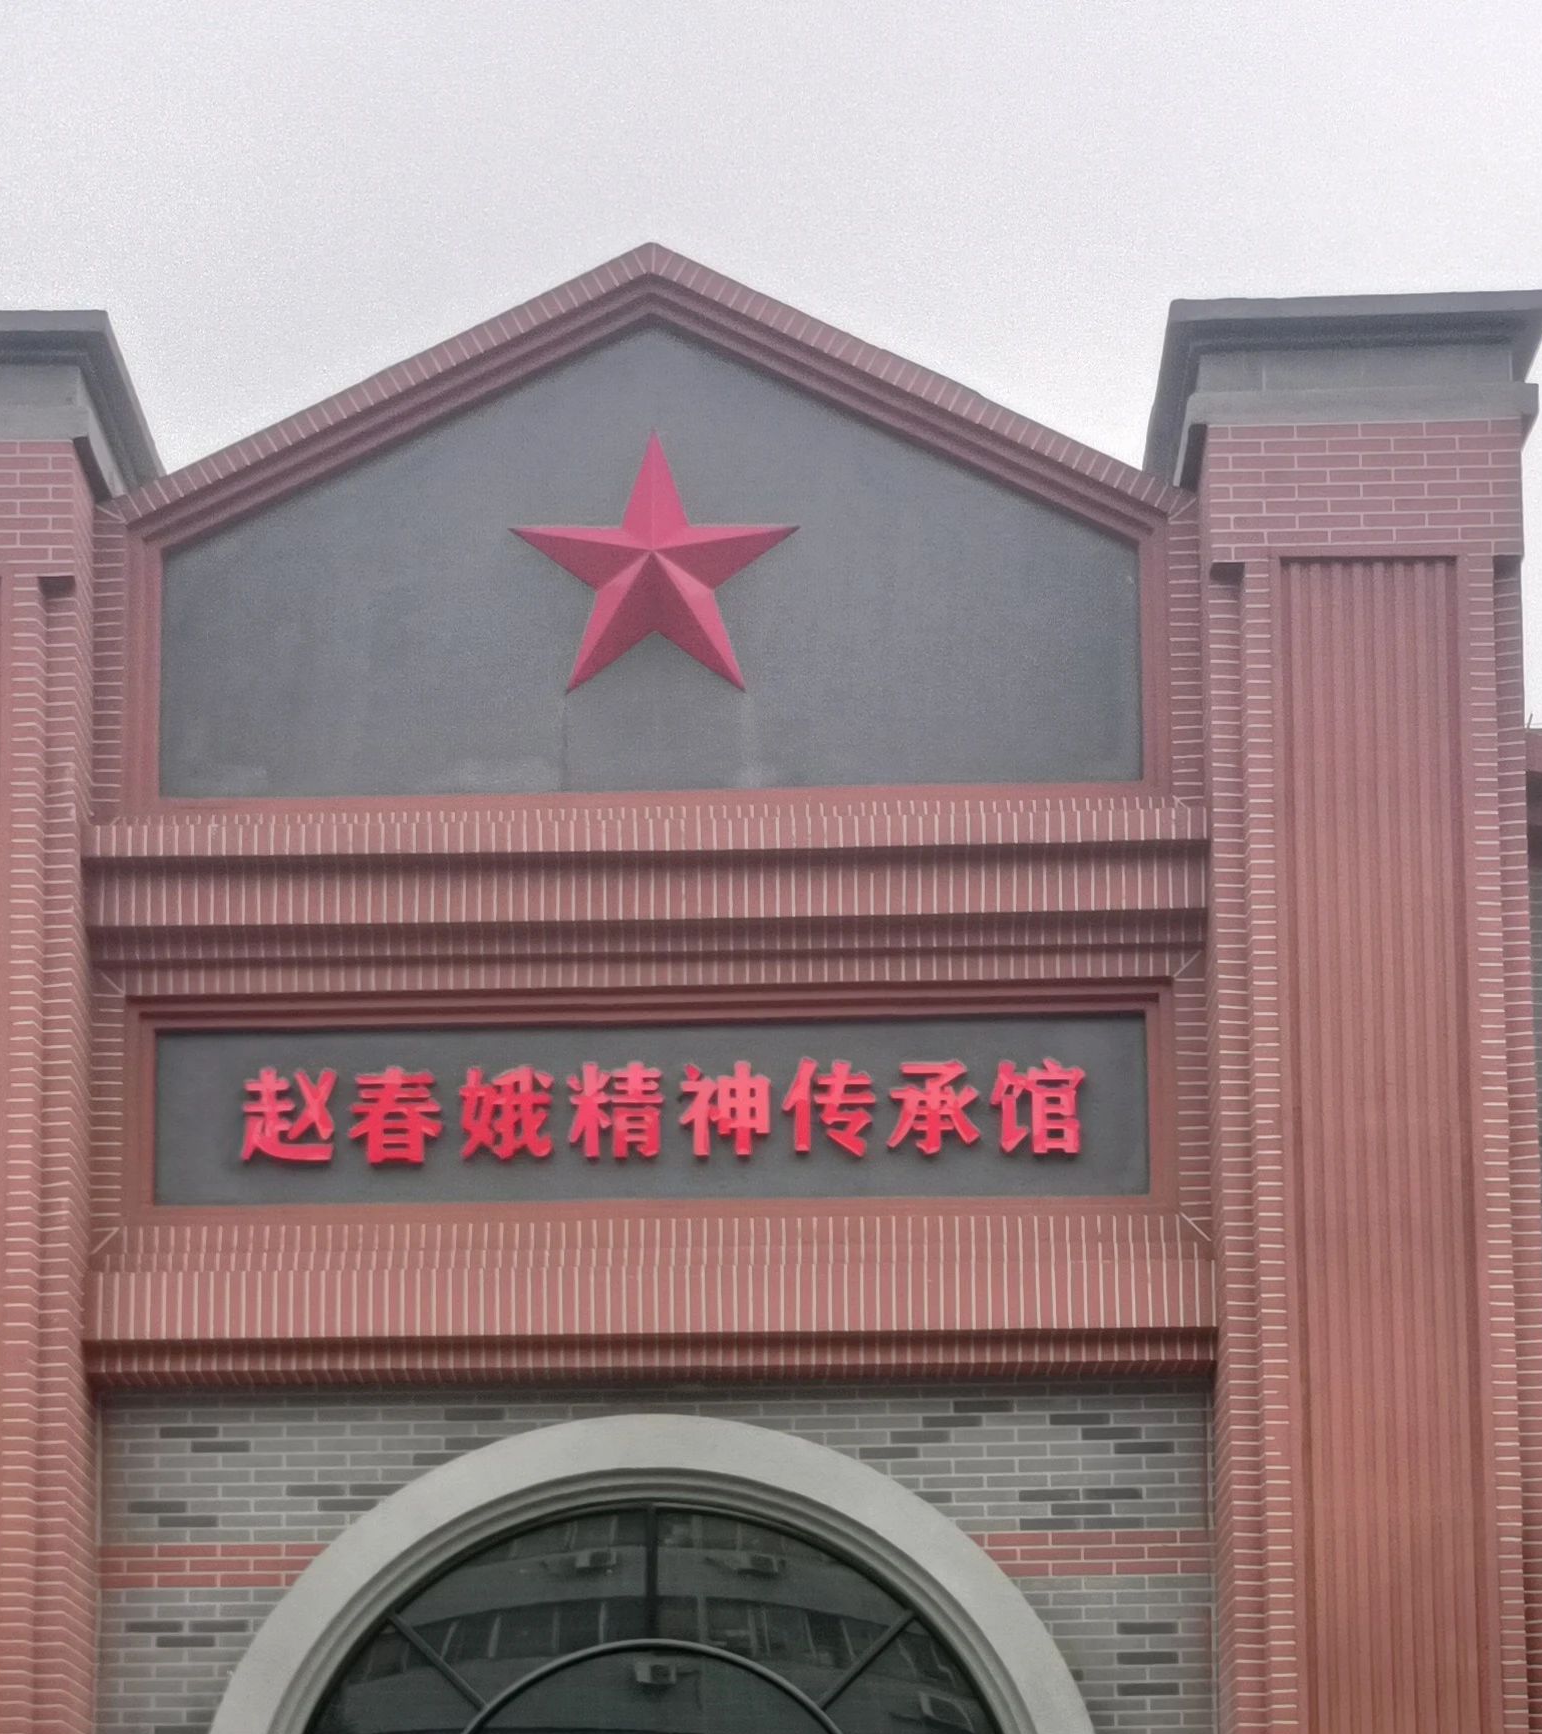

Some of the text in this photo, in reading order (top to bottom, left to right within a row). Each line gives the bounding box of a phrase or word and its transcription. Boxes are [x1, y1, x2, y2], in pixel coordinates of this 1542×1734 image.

[239, 1058, 1086, 1164] 赵春娥精神传承馆
